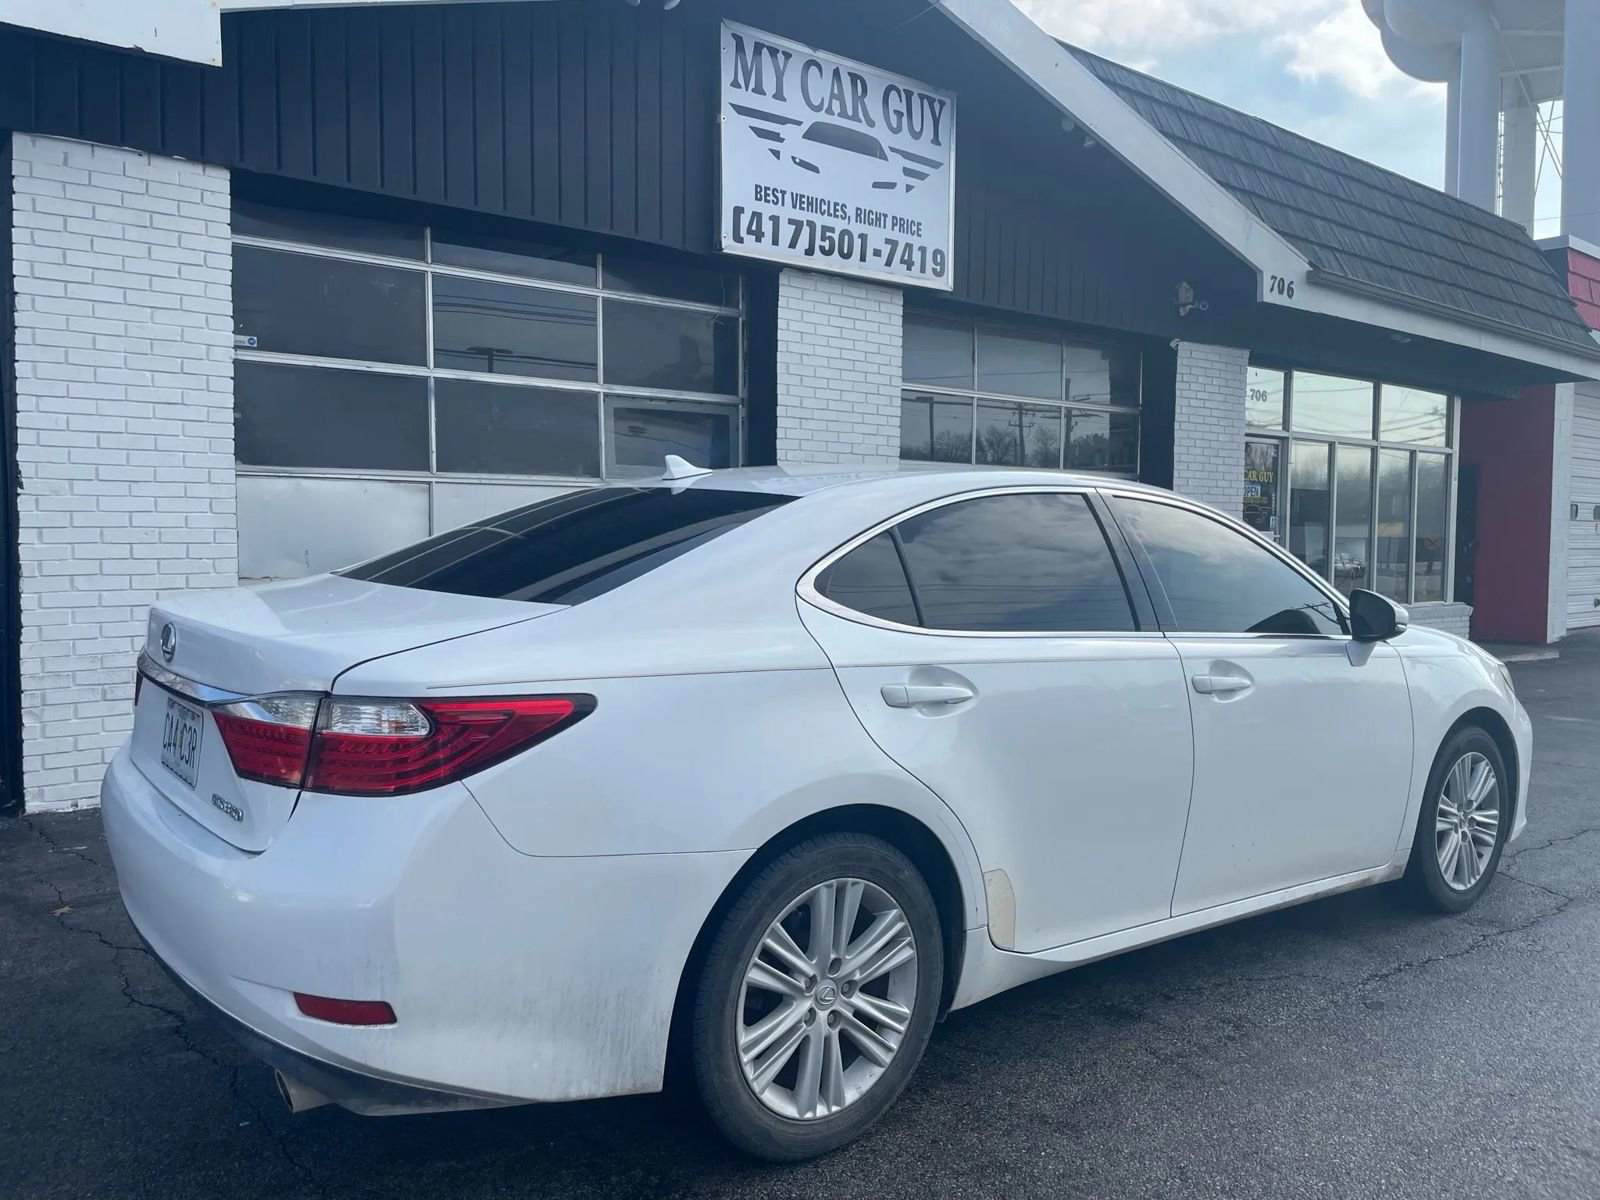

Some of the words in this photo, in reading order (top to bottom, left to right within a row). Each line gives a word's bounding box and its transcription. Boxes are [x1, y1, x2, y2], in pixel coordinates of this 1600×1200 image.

[730, 33, 792, 101] MY
[801, 59, 875, 128] CAR
[882, 84, 946, 146] GUY
[754, 184, 787, 206] BEST
[790, 192, 850, 224] VEHICLES,
[855, 207, 888, 230] RIGHT
[891, 217, 922, 238] PRICE
[732, 206, 945, 277] (417)501-7419
[1270, 275, 1294, 299] 706
[1250, 388, 1268, 402] 706
[1258, 471, 1274, 482] GUY
